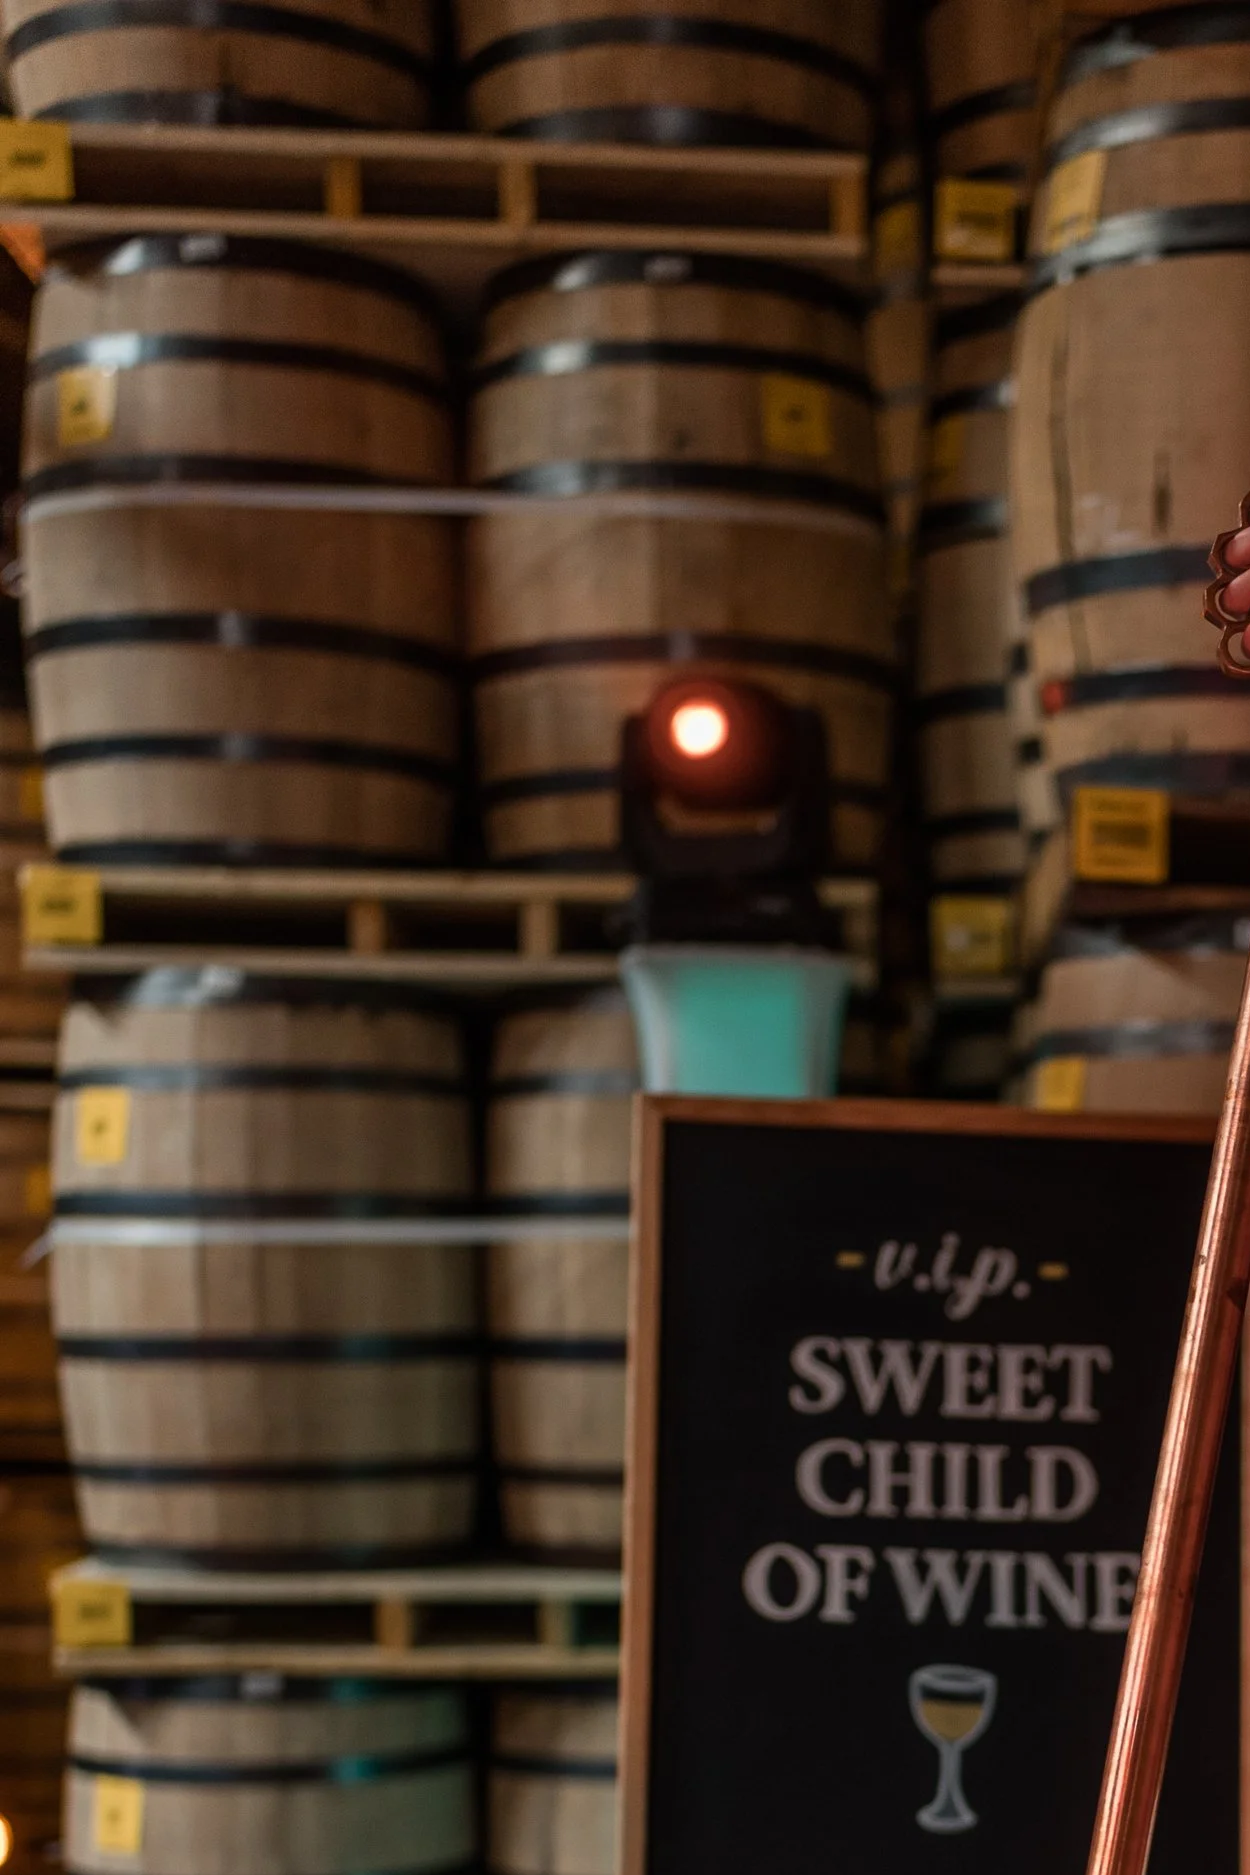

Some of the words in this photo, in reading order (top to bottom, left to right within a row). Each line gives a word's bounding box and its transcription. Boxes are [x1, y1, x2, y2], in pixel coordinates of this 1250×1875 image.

[789, 1336, 1112, 1422] SWEET
[795, 1439, 1098, 1522] CHILD
[742, 1542, 877, 1624] OF
[884, 1548, 1143, 1632] WINE
